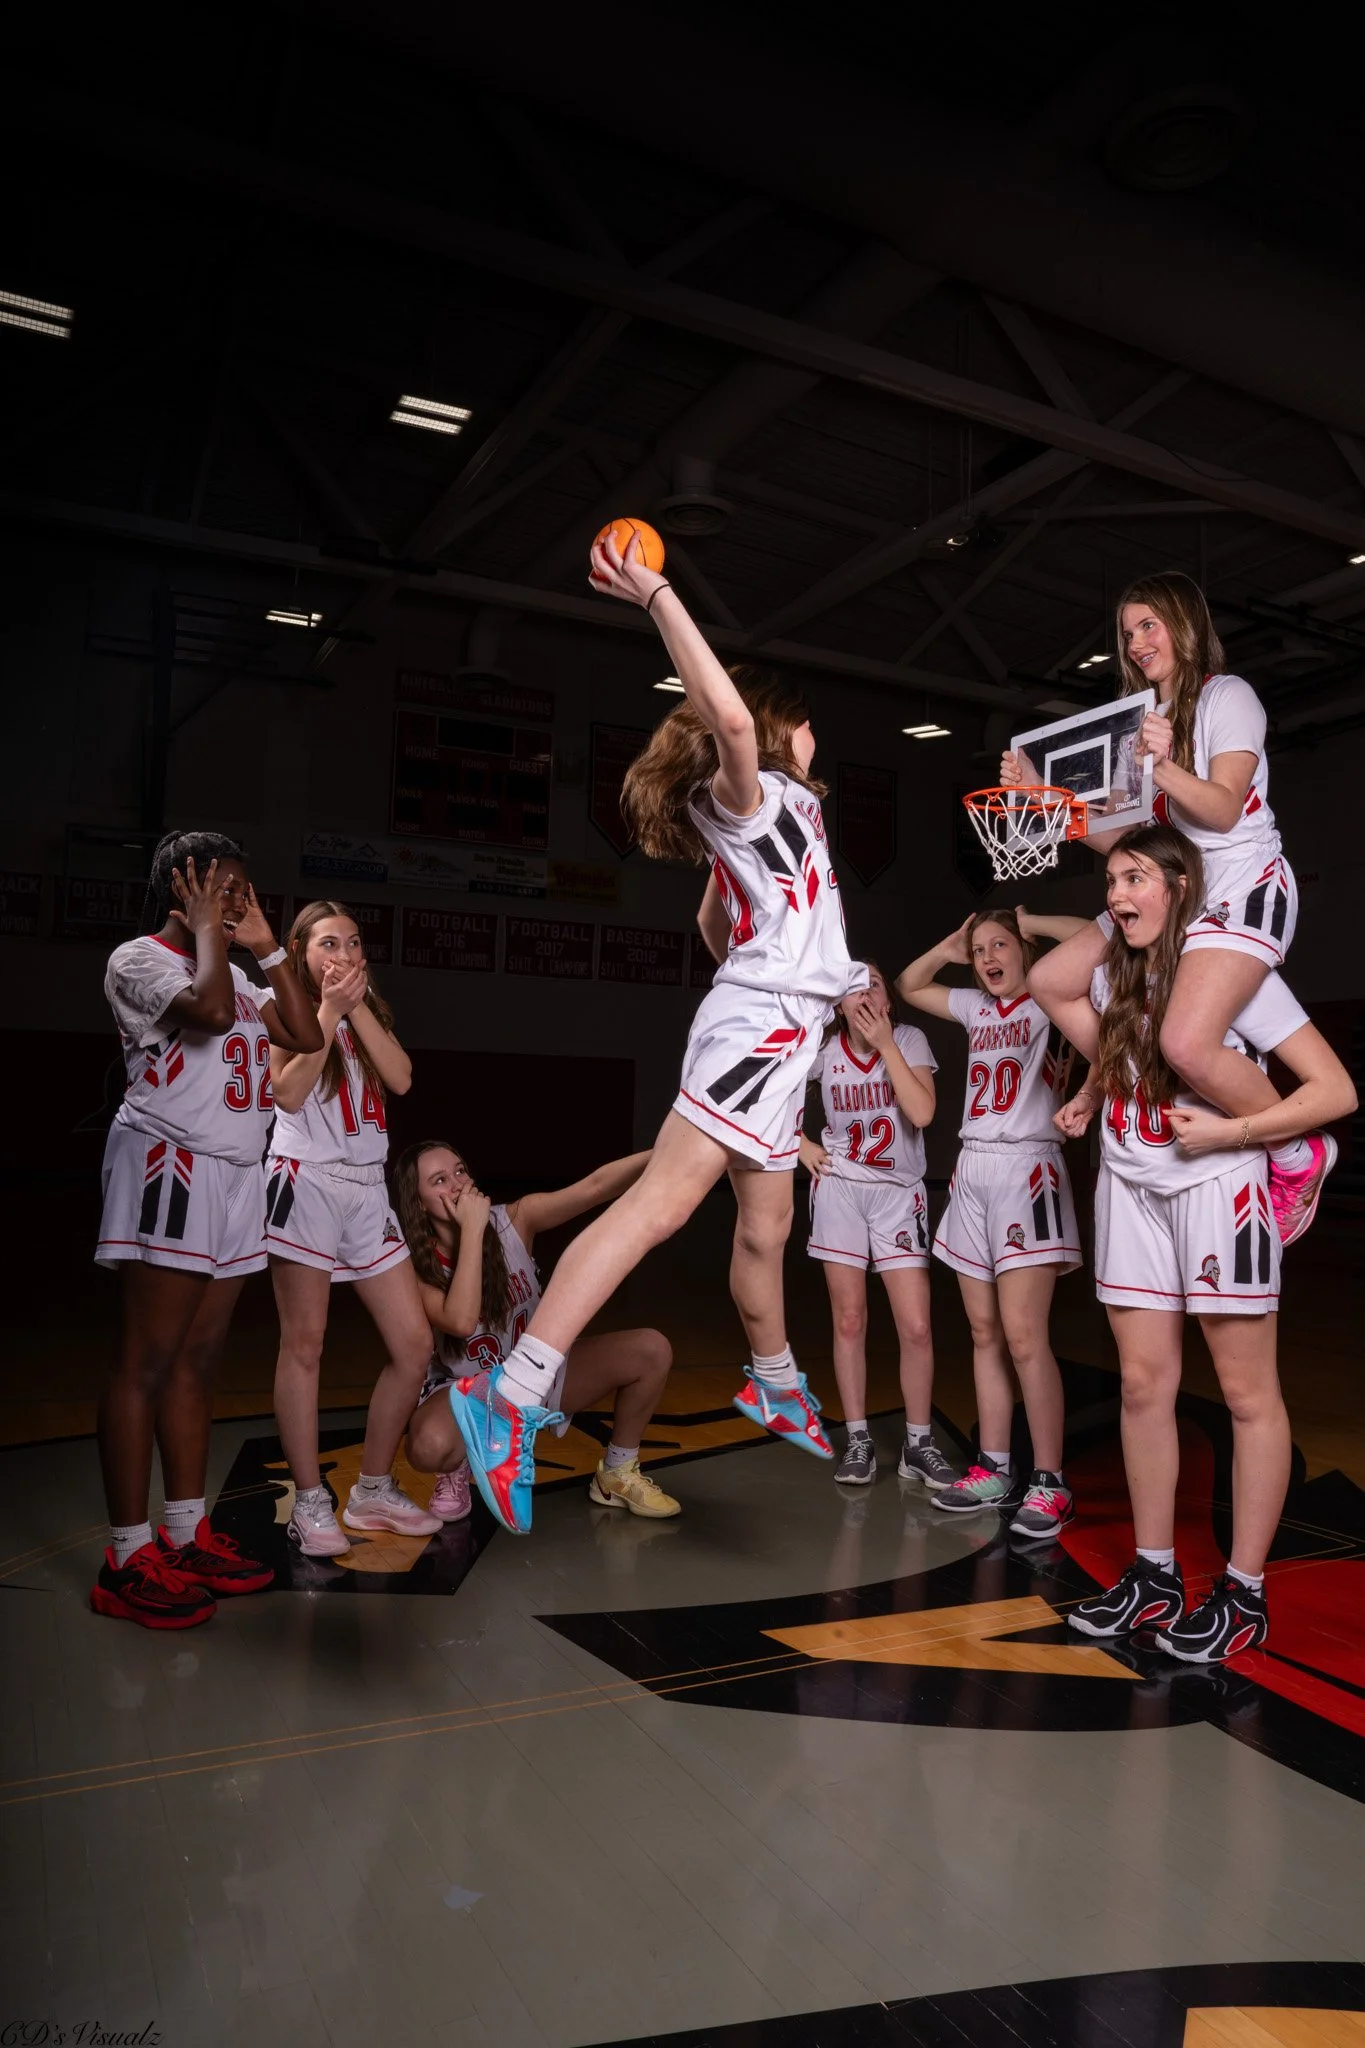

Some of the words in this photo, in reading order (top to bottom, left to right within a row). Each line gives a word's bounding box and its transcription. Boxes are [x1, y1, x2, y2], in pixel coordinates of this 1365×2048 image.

[404, 745, 440, 761] HOME
[461, 759, 490, 771] PERIOD
[508, 758, 546, 776] GUEST
[446, 793, 477, 806] PLAYER
[1115, 797, 1140, 812] SPALDING
[394, 821, 421, 833] SCORE
[458, 828, 487, 841] MATCH
[521, 835, 547, 848] SCORE
[86, 901, 118, 920] 201
[408, 910, 491, 933] FOOTBALL
[510, 920, 590, 942] FOOTBALL
[535, 940, 565, 957] 2017
[606, 929, 679, 950] BASEBALL
[405, 947, 432, 965] STATE
[450, 951, 492, 970] CHAMPIONS
[508, 955, 532, 972] STATE
[600, 960, 625, 979] STATE
[222, 1032, 274, 1113] 32
[830, 1079, 900, 1113] GLADIATOR
[969, 1056, 1024, 1121] 20
[338, 1071, 388, 1137] 14
[845, 1115, 896, 1170] 12
